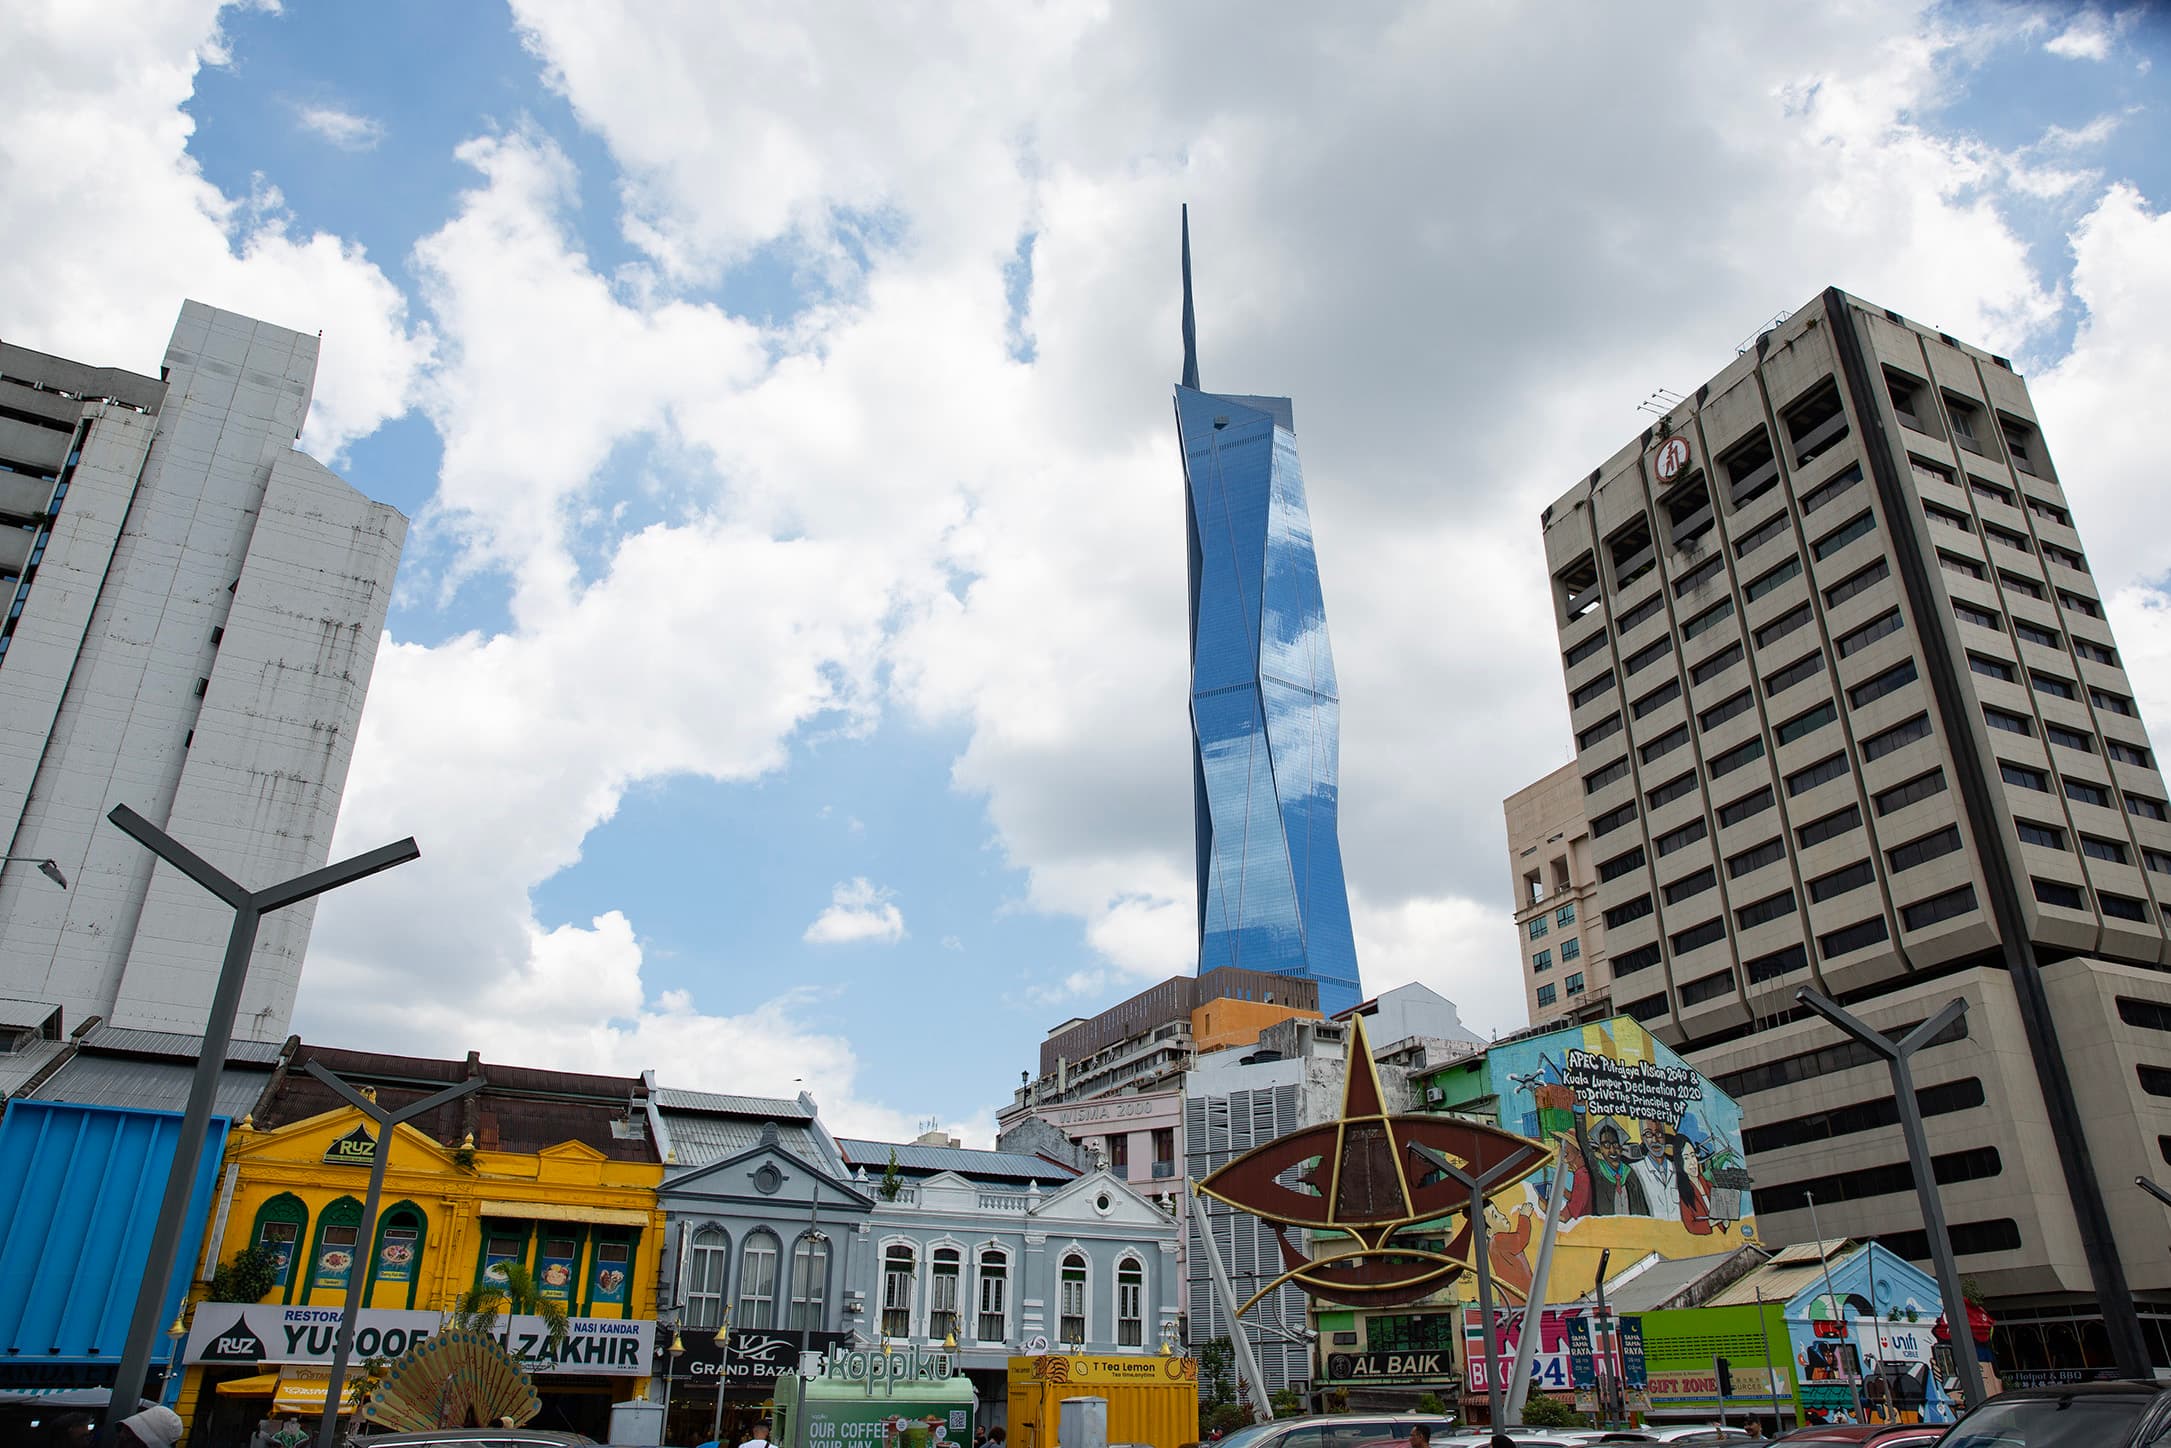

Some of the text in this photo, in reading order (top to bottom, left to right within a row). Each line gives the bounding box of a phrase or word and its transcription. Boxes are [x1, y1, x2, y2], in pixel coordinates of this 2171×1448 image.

[1569, 1051, 1699, 1085] APEC Putrajaya Vision 2040 &
[1563, 1070, 1701, 1099] Kuala Lumpur Declaration 2020
[1589, 1100, 1626, 1114] Shared
[1632, 1094, 1670, 1110] Principle
[1058, 1101, 1152, 1124] WISMA 2000
[285, 1310, 344, 1323] RESTORA
[574, 1322, 640, 1335] NASI KANDAR
[518, 1334, 640, 1366] ZAKHIR
[1571, 1348, 1592, 1356] RAYA
[690, 1361, 750, 1377] GRAND
[827, 1341, 954, 1397] koppiku
[1093, 1362, 1156, 1372] T Tea Lemon
[1353, 1354, 1441, 1374] AL BAIK
[2049, 1372, 2057, 1380] &
[2059, 1371, 2082, 1380] BBQ
[1648, 1379, 1678, 1393] GIFT
[1682, 1377, 1717, 1393] ZONE
[809, 1422, 890, 1439] OUR COFFEE
